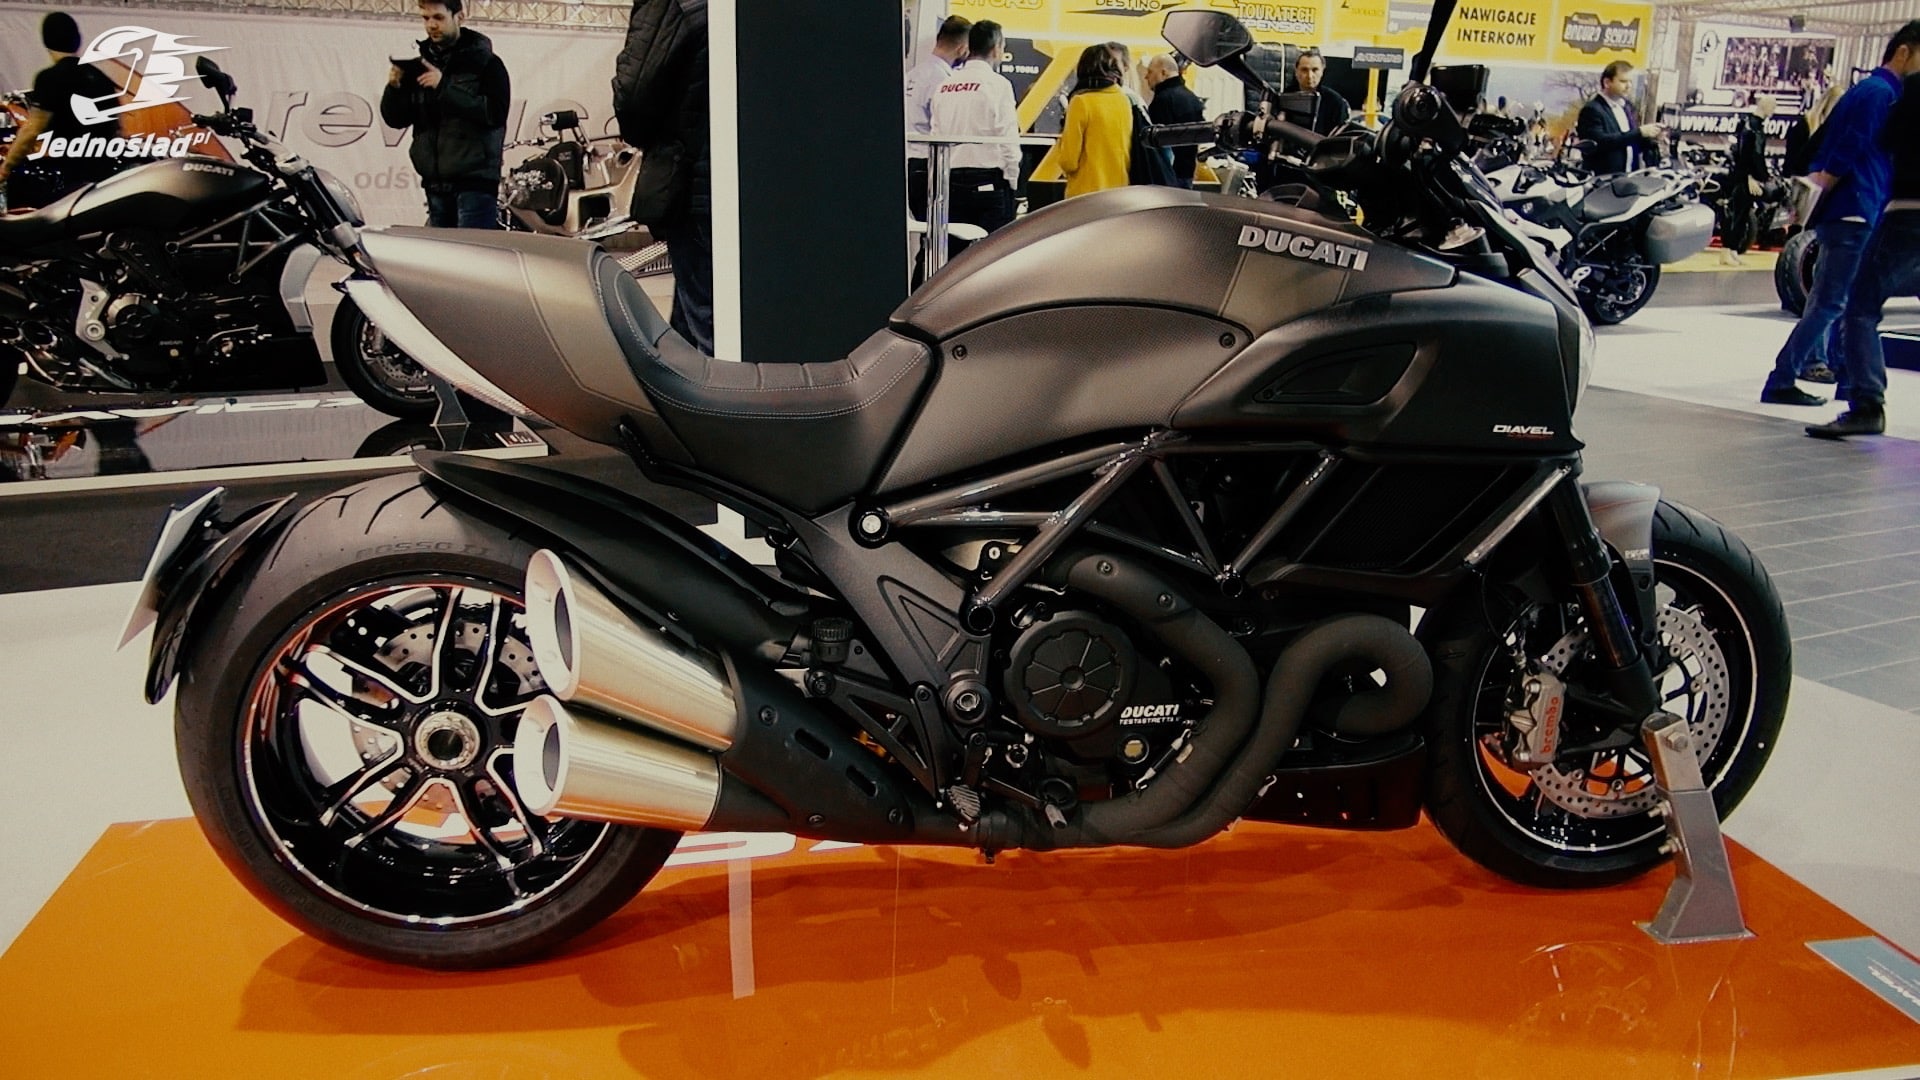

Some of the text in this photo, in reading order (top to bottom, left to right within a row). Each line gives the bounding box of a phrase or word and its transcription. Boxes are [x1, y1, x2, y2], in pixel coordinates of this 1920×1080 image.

[1238, 3, 1315, 24] TOURATECH
[1459, 7, 1537, 26] NAWIGACJE
[1240, 19, 1314, 34] PENSION
[1457, 28, 1536, 47] INTERKOMY
[940, 82, 981, 94] DUCATI
[182, 162, 235, 177] DUCATI
[1237, 224, 1369, 272] DUCATI
[1492, 424, 1555, 436] DIAVEL
[1120, 703, 1180, 719] DUCATI
[1541, 696, 1560, 755] brembo
